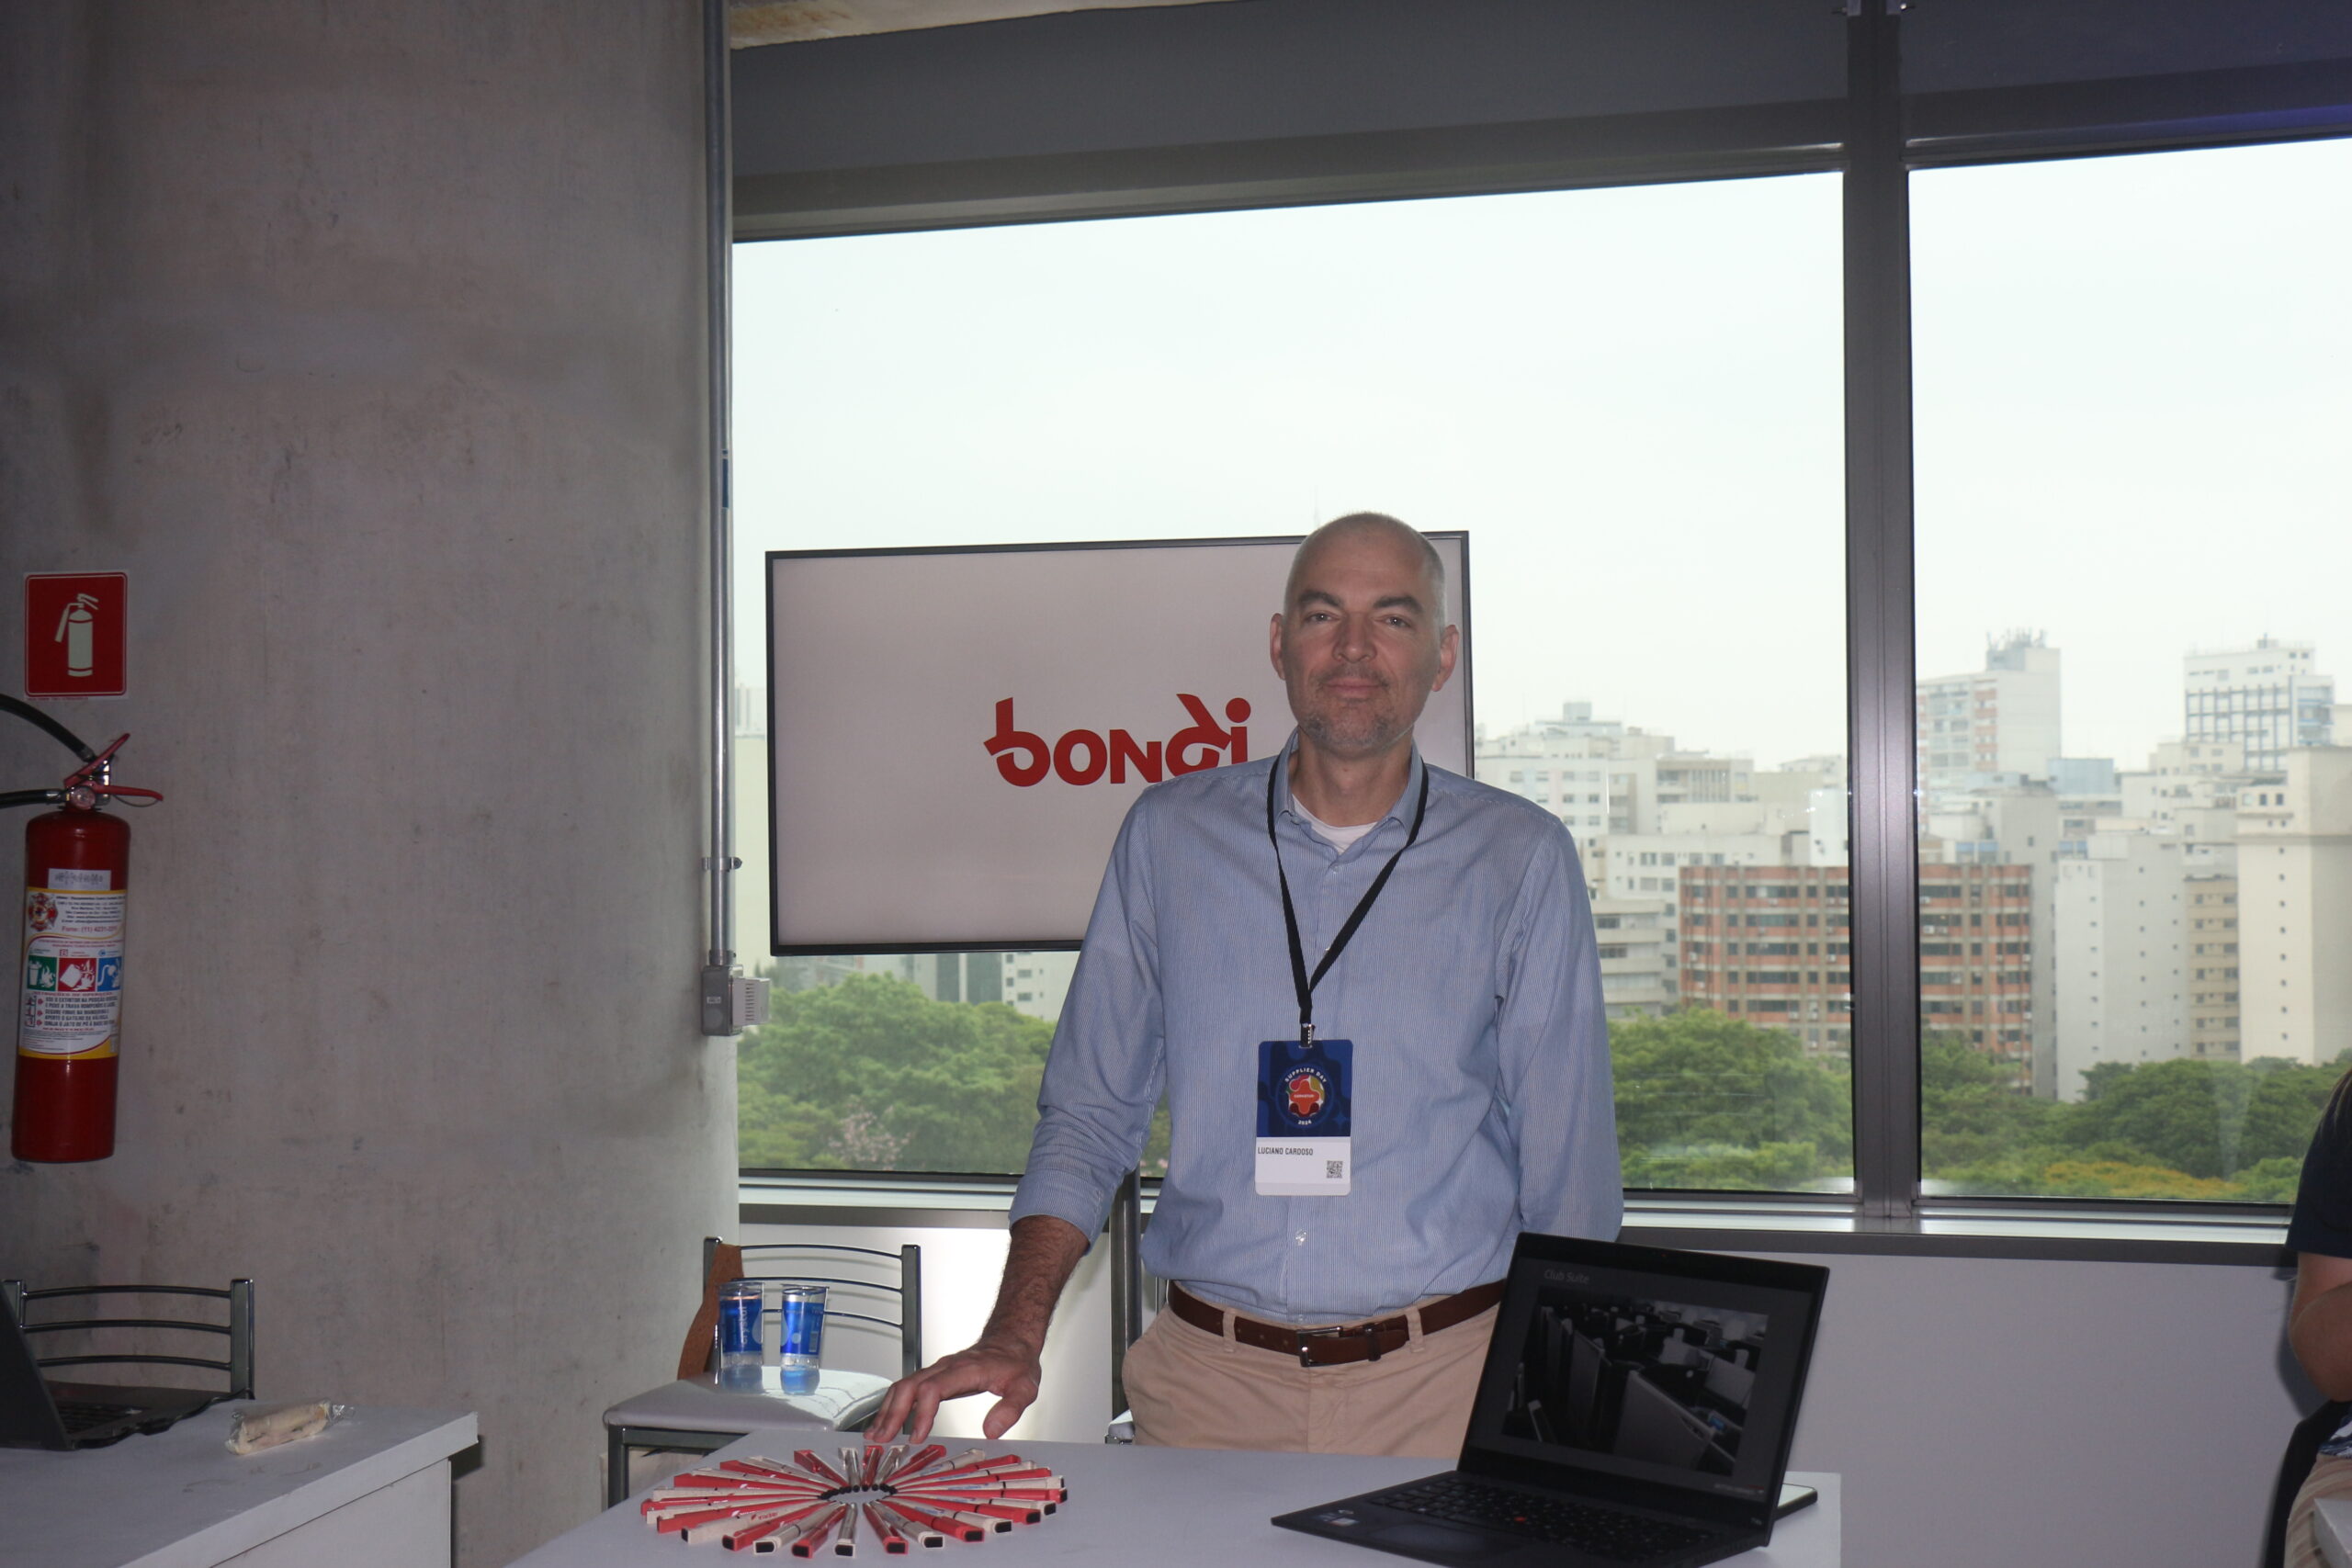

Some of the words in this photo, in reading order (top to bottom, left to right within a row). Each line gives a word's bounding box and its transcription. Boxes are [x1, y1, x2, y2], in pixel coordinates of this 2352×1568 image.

[1284, 1067, 1315, 1082] SUPPLIER
[1316, 1071, 1328, 1082] DAY
[1284, 1147, 1314, 1156] CARDOSO
[1543, 1269, 1566, 1280] Club
[1566, 1271, 1590, 1284] Suite
